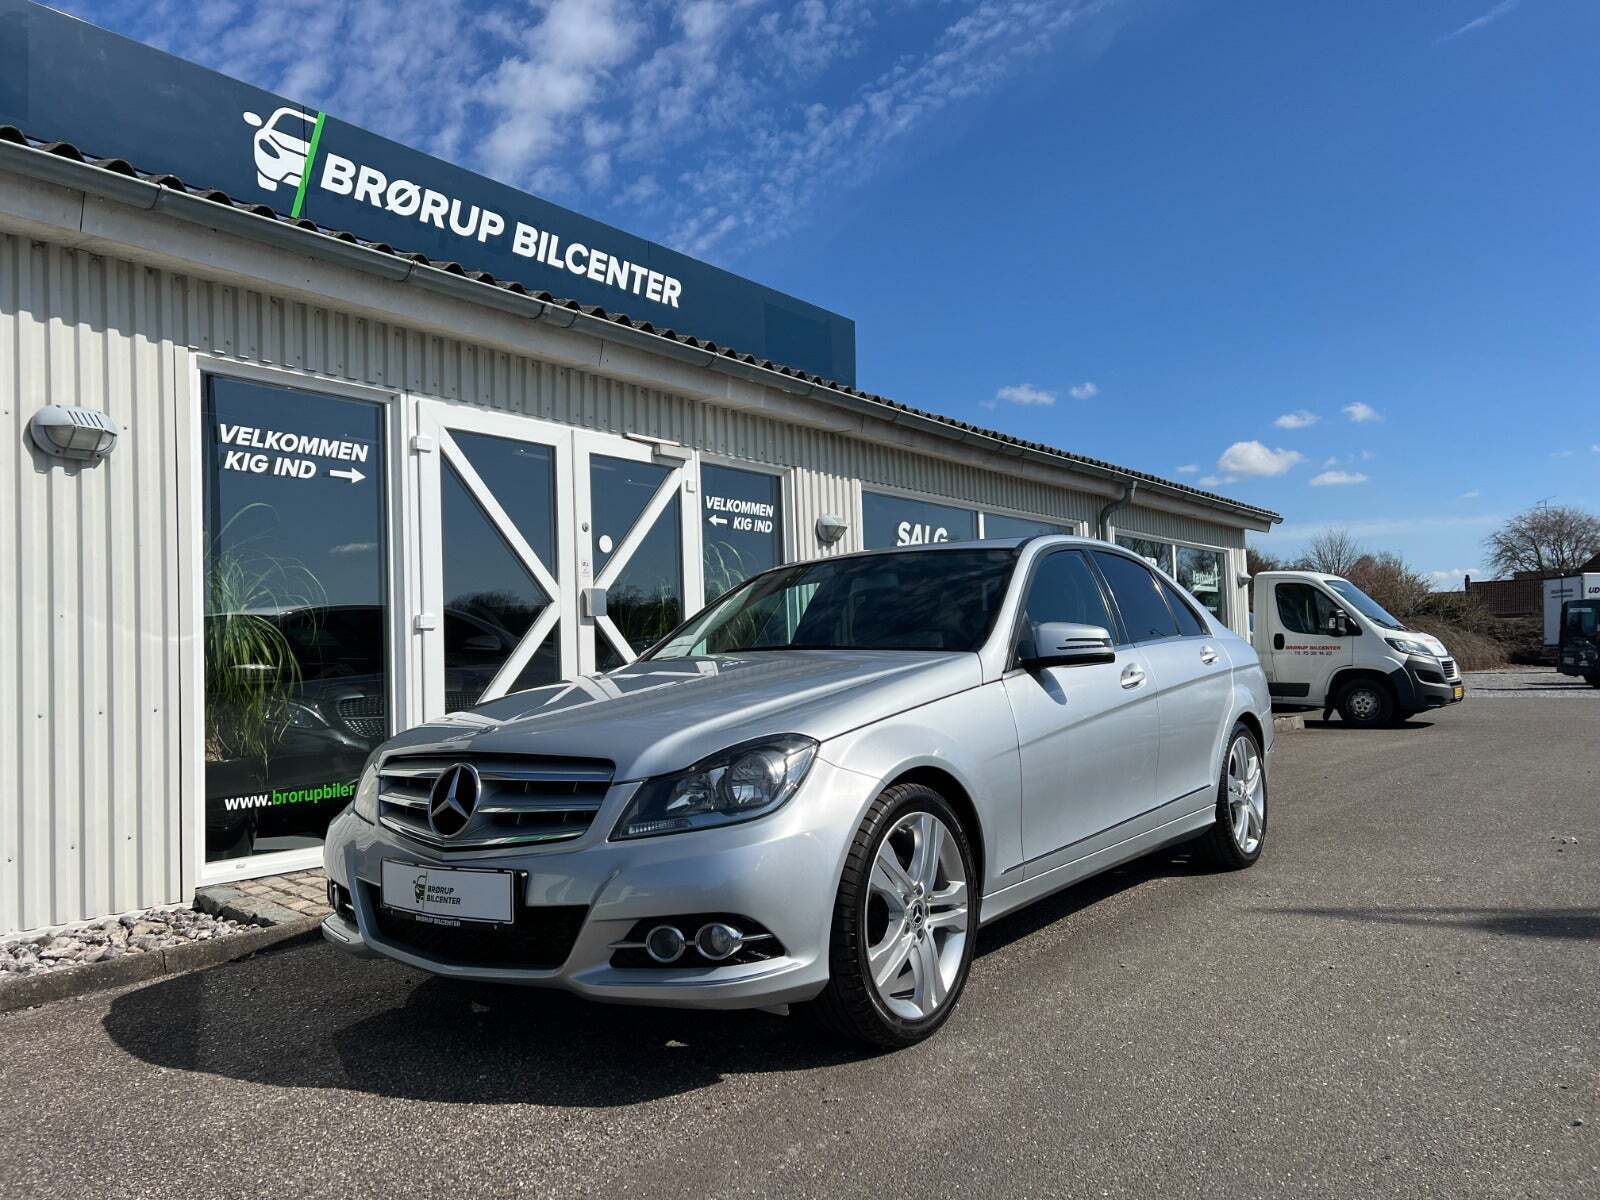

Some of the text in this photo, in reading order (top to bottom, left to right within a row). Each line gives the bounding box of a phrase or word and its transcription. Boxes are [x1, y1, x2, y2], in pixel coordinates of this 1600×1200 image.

[320, 152, 682, 308] BRØRUP BILCENTER
[220, 423, 369, 462] VELKOMMEN
[224, 450, 317, 479] KIG IND
[705, 495, 774, 518] VELKOMMEN
[733, 516, 773, 533] KIG IND
[896, 521, 948, 546] SALG
[224, 782, 356, 811] www.brorupbiler
[426, 894, 461, 905] BILCENTER
